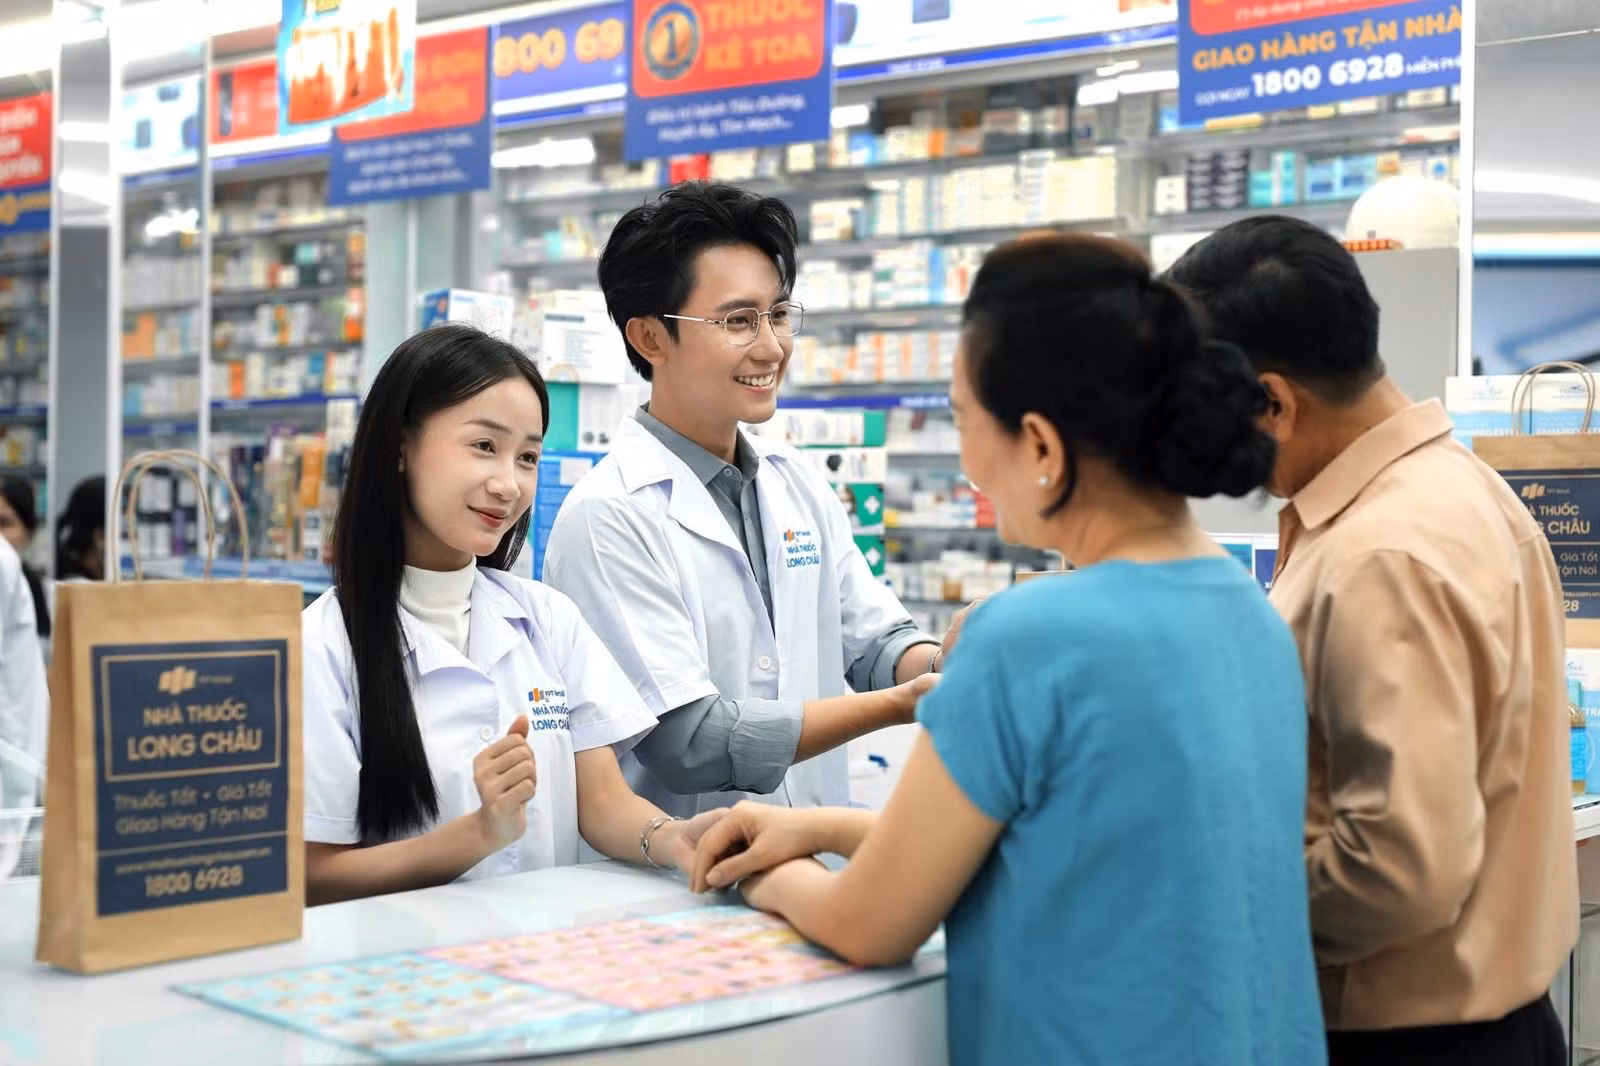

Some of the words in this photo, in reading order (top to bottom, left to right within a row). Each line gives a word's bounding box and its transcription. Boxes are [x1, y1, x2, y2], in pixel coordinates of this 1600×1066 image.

[752, 32, 814, 65] TOA
[1192, 42, 1255, 72] GIAO
[1261, 30, 1337, 63] HÀNG
[1342, 17, 1398, 53] TẬN
[1404, 4, 1462, 40] NHÀ
[1251, 64, 1321, 98] 1800
[1328, 52, 1404, 87] 6928
[1539, 501, 1580, 516] THUỐC
[1548, 517, 1590, 535] CHÂU
[786, 557, 806, 568] LONG
[143, 702, 184, 727] NHÀ
[187, 697, 248, 723] THUỐC
[532, 703, 550, 716] NHÀ
[532, 719, 558, 731] LONG
[127, 733, 197, 762] LONG
[201, 724, 263, 755] CHÂU
[145, 871, 192, 898] 1800
[194, 864, 245, 891] 6928
